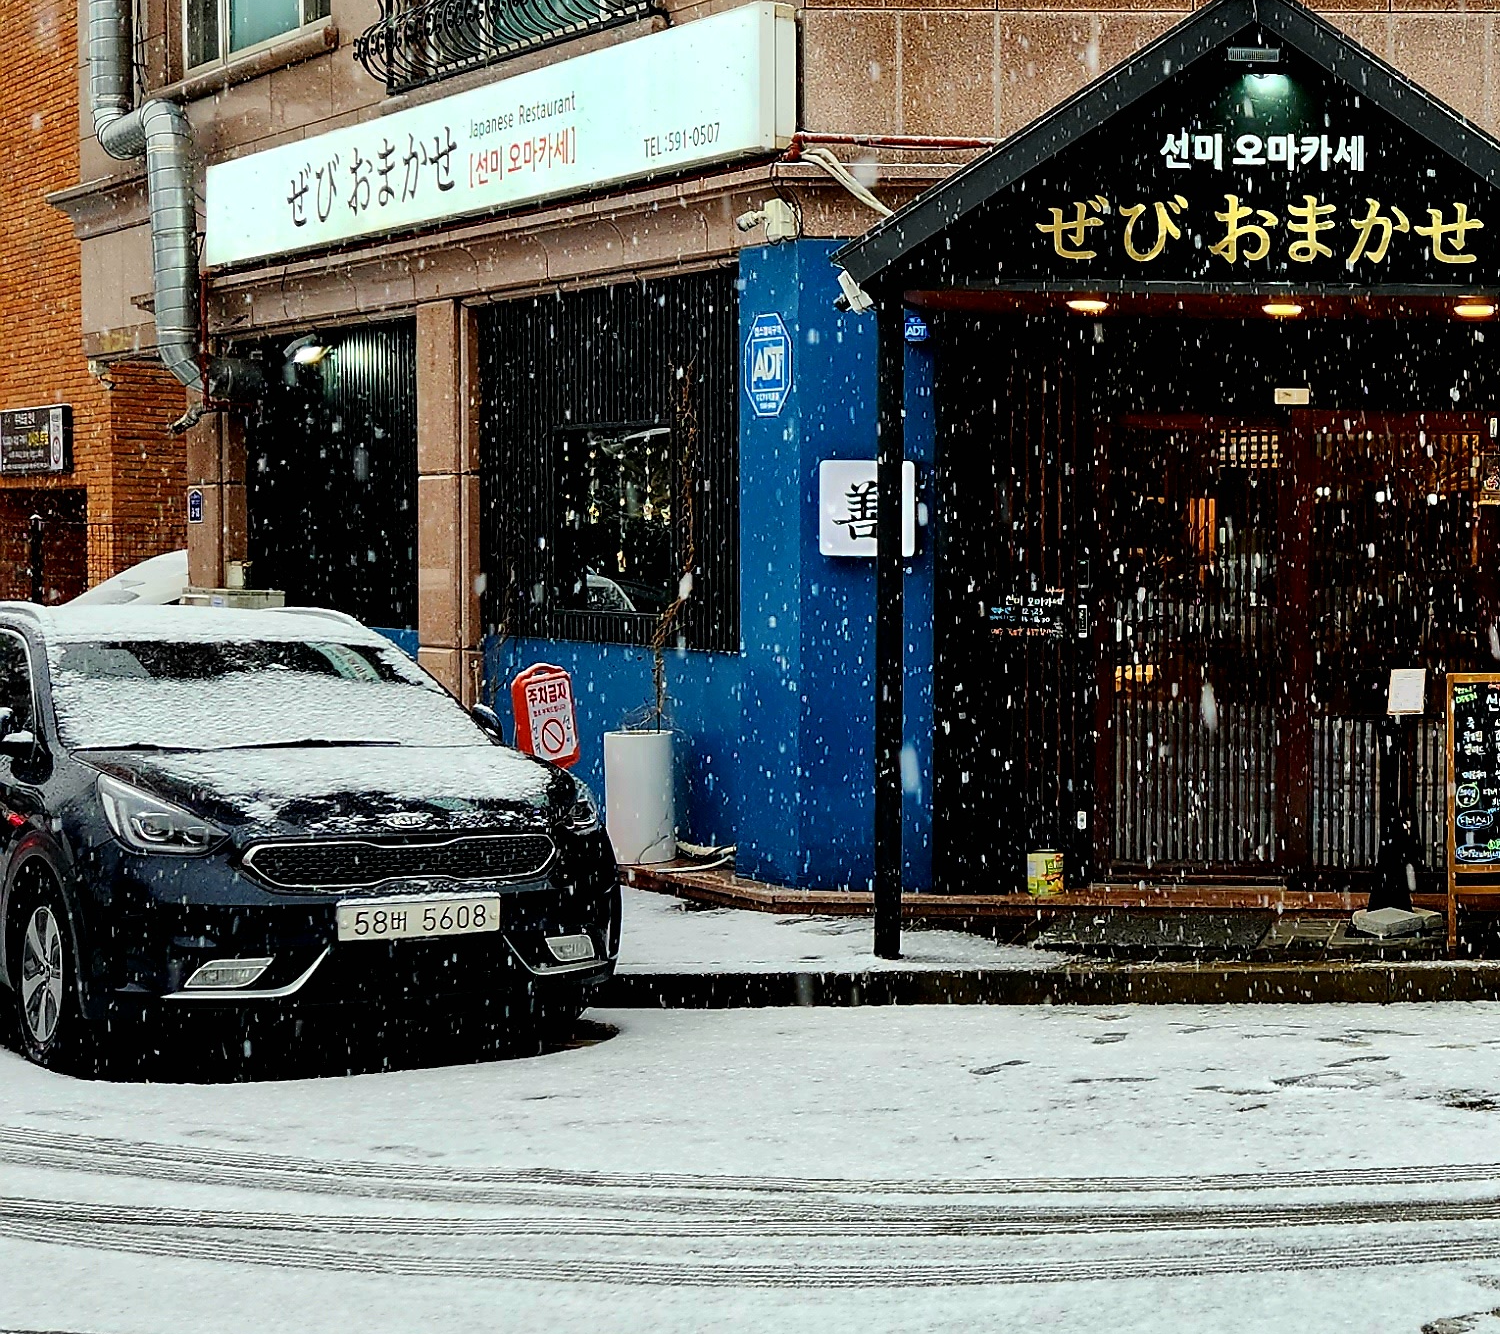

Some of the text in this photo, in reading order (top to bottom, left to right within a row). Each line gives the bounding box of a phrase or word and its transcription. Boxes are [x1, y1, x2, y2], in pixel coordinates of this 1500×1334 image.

[469, 90, 576, 140] Japanese Restaurant
[1159, 132, 1365, 171] 선미 오마카세
[905, 325, 926, 336] ADT
[753, 346, 784, 382] ADT
[528, 682, 567, 707] 주차금지
[354, 904, 486, 935] 58버 5608
